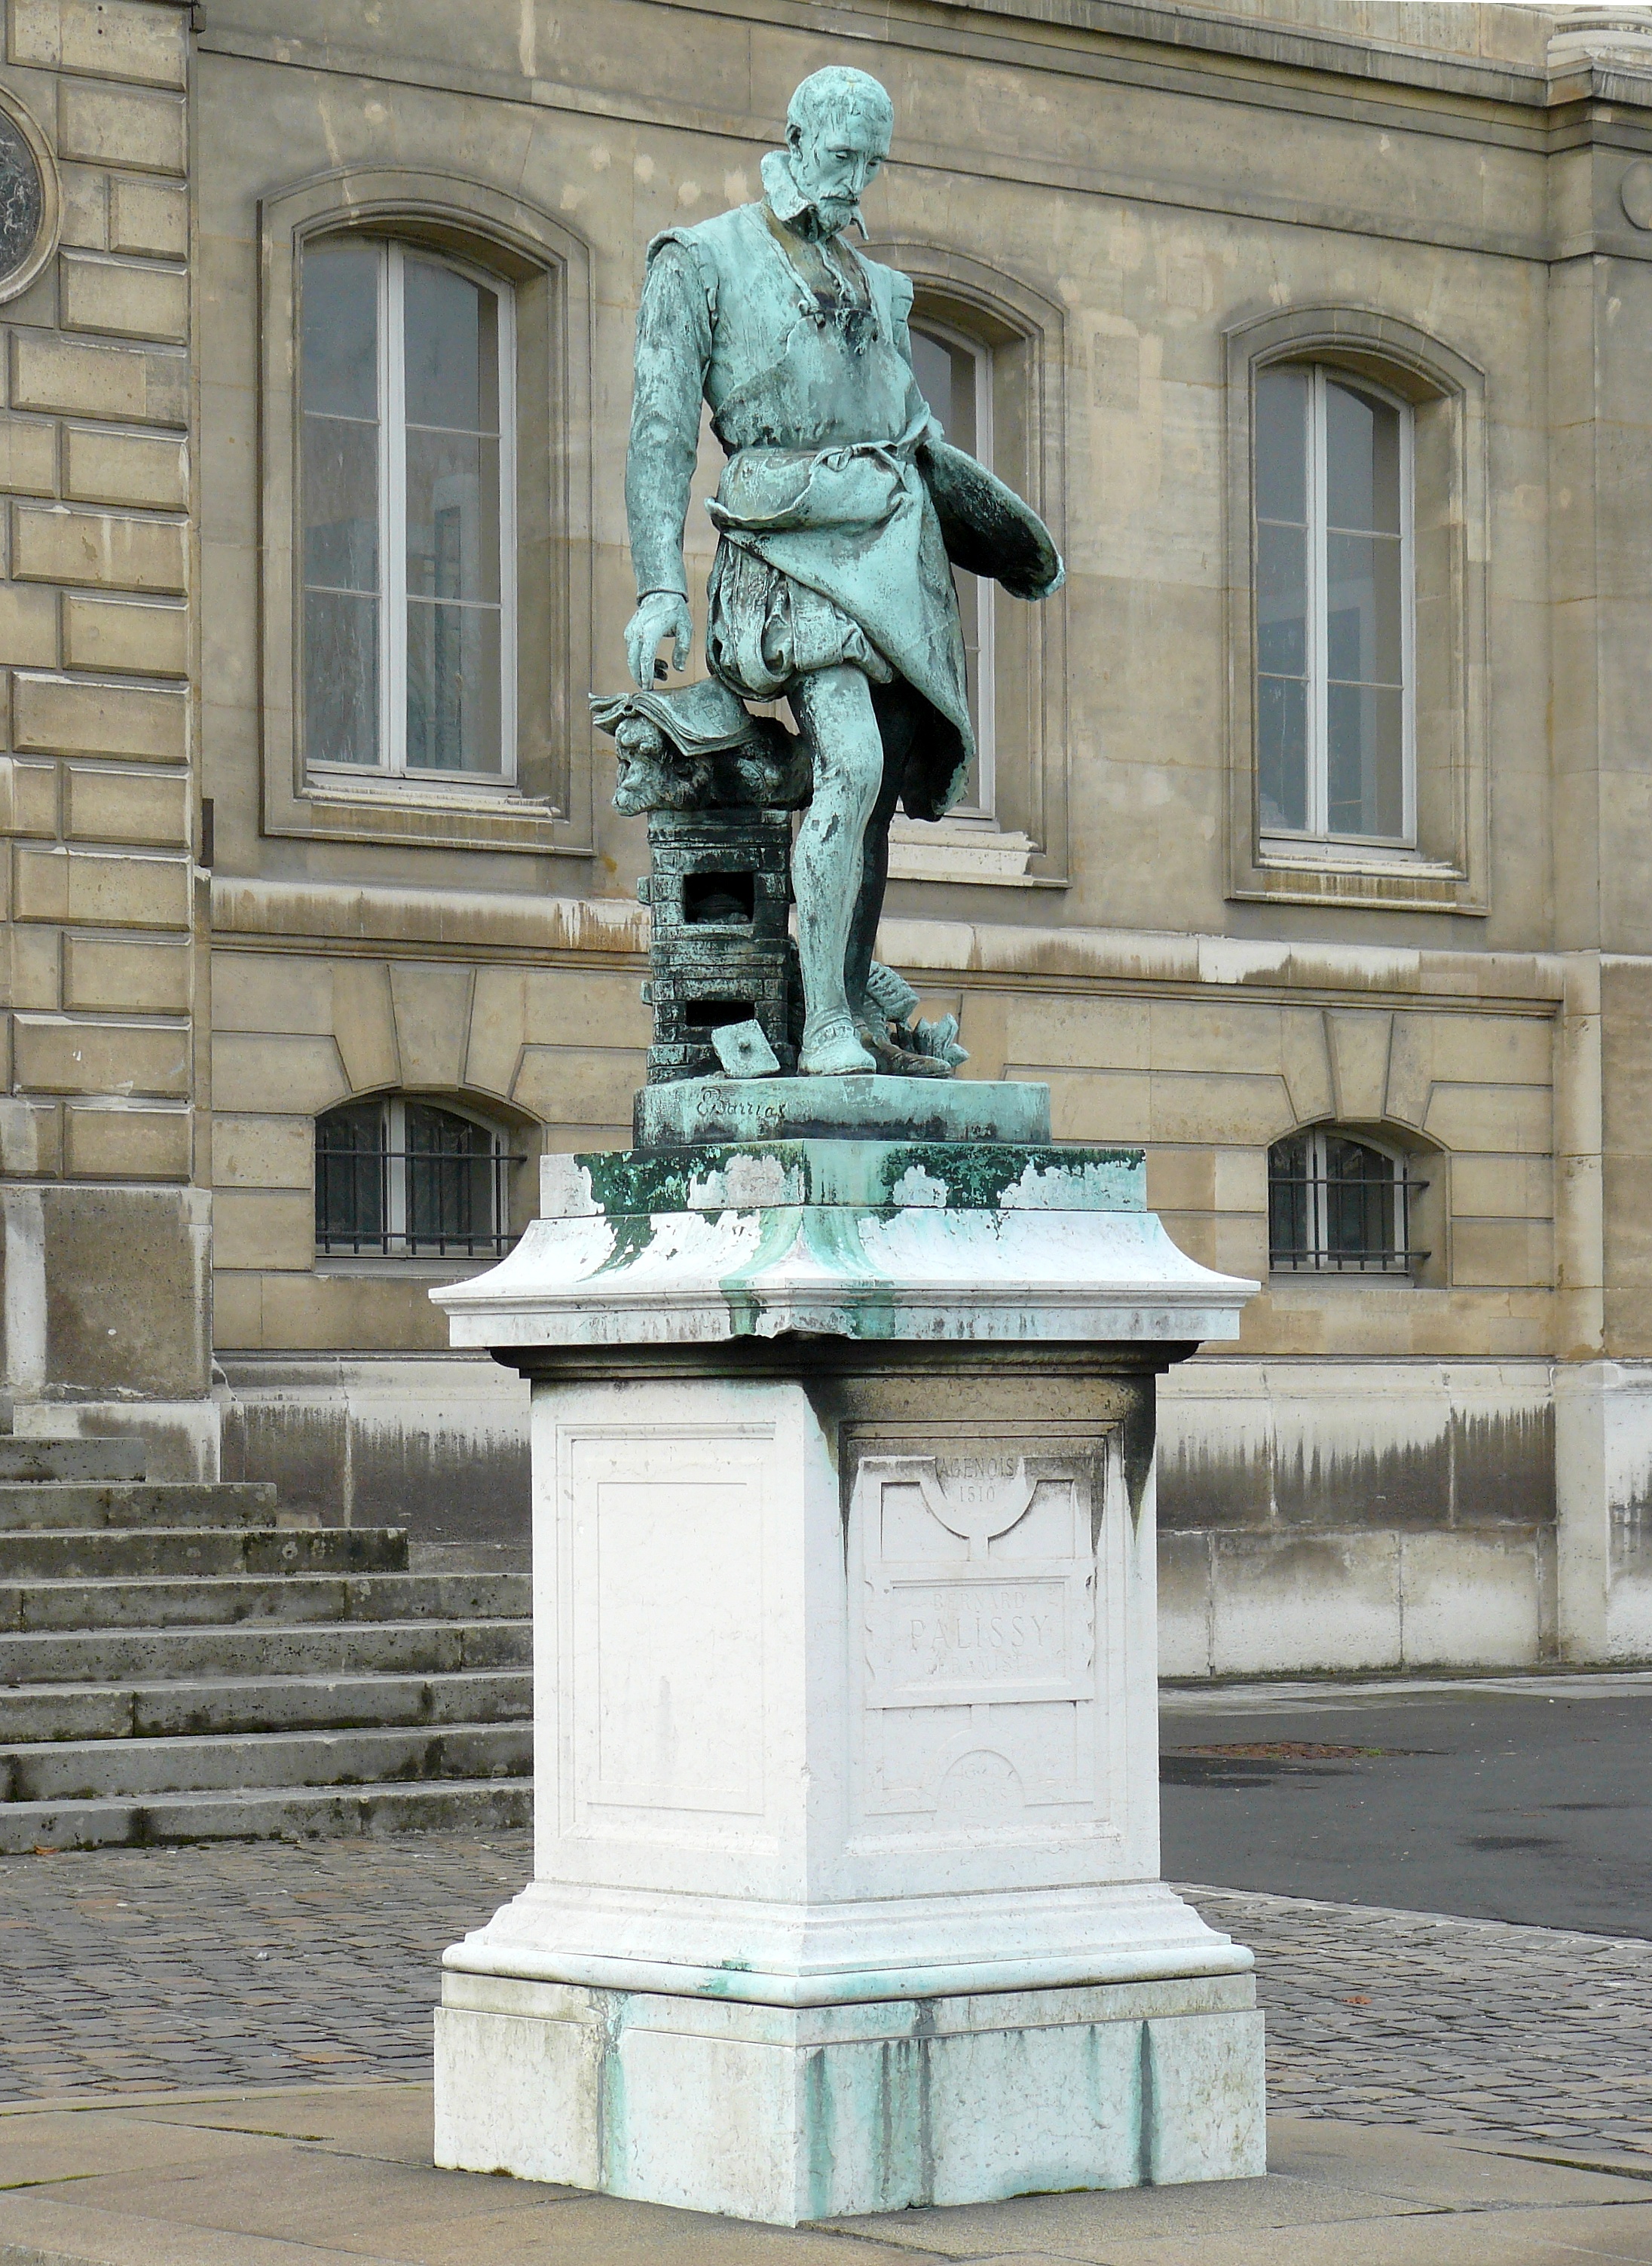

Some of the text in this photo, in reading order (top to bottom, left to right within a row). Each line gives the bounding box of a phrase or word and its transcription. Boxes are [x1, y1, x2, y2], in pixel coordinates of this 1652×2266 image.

[938, 1457, 1018, 1479] AGENOIS
[959, 1486, 996, 1502] 1510
[933, 1591, 1026, 1610] BERNARD
[910, 1614, 1049, 1651] PALISSY
